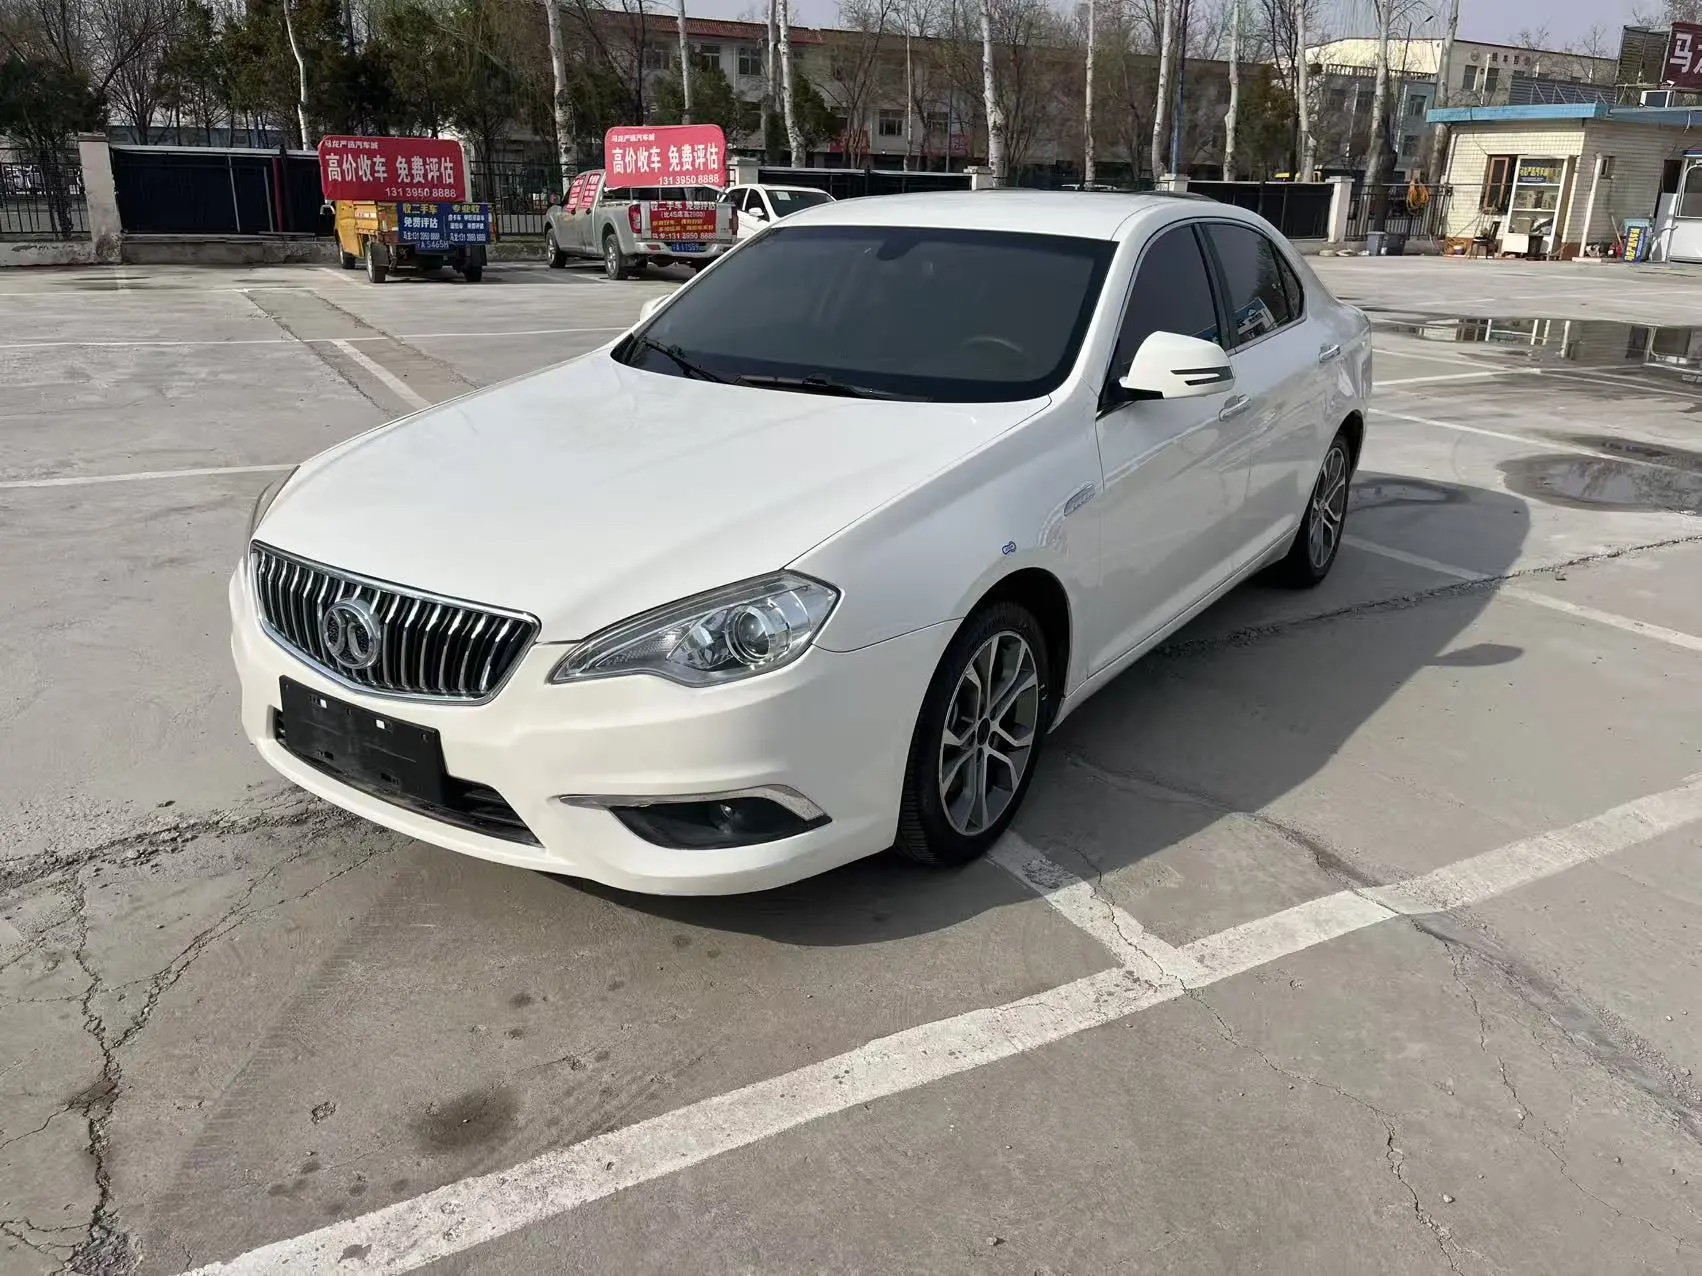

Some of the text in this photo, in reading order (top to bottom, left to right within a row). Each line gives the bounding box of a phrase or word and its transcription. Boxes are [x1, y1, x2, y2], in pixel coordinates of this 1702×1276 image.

[612, 143, 719, 174] 高价收车 免费评估
[326, 153, 454, 184] 高价收车 免费评估
[658, 174, 719, 185] 131 3950 8888
[385, 187, 457, 198] 131 3950 8888
[402, 203, 438, 215] 收二手车
[650, 201, 716, 211] 收二手车 免费评估
[403, 216, 438, 229] 免费评估
